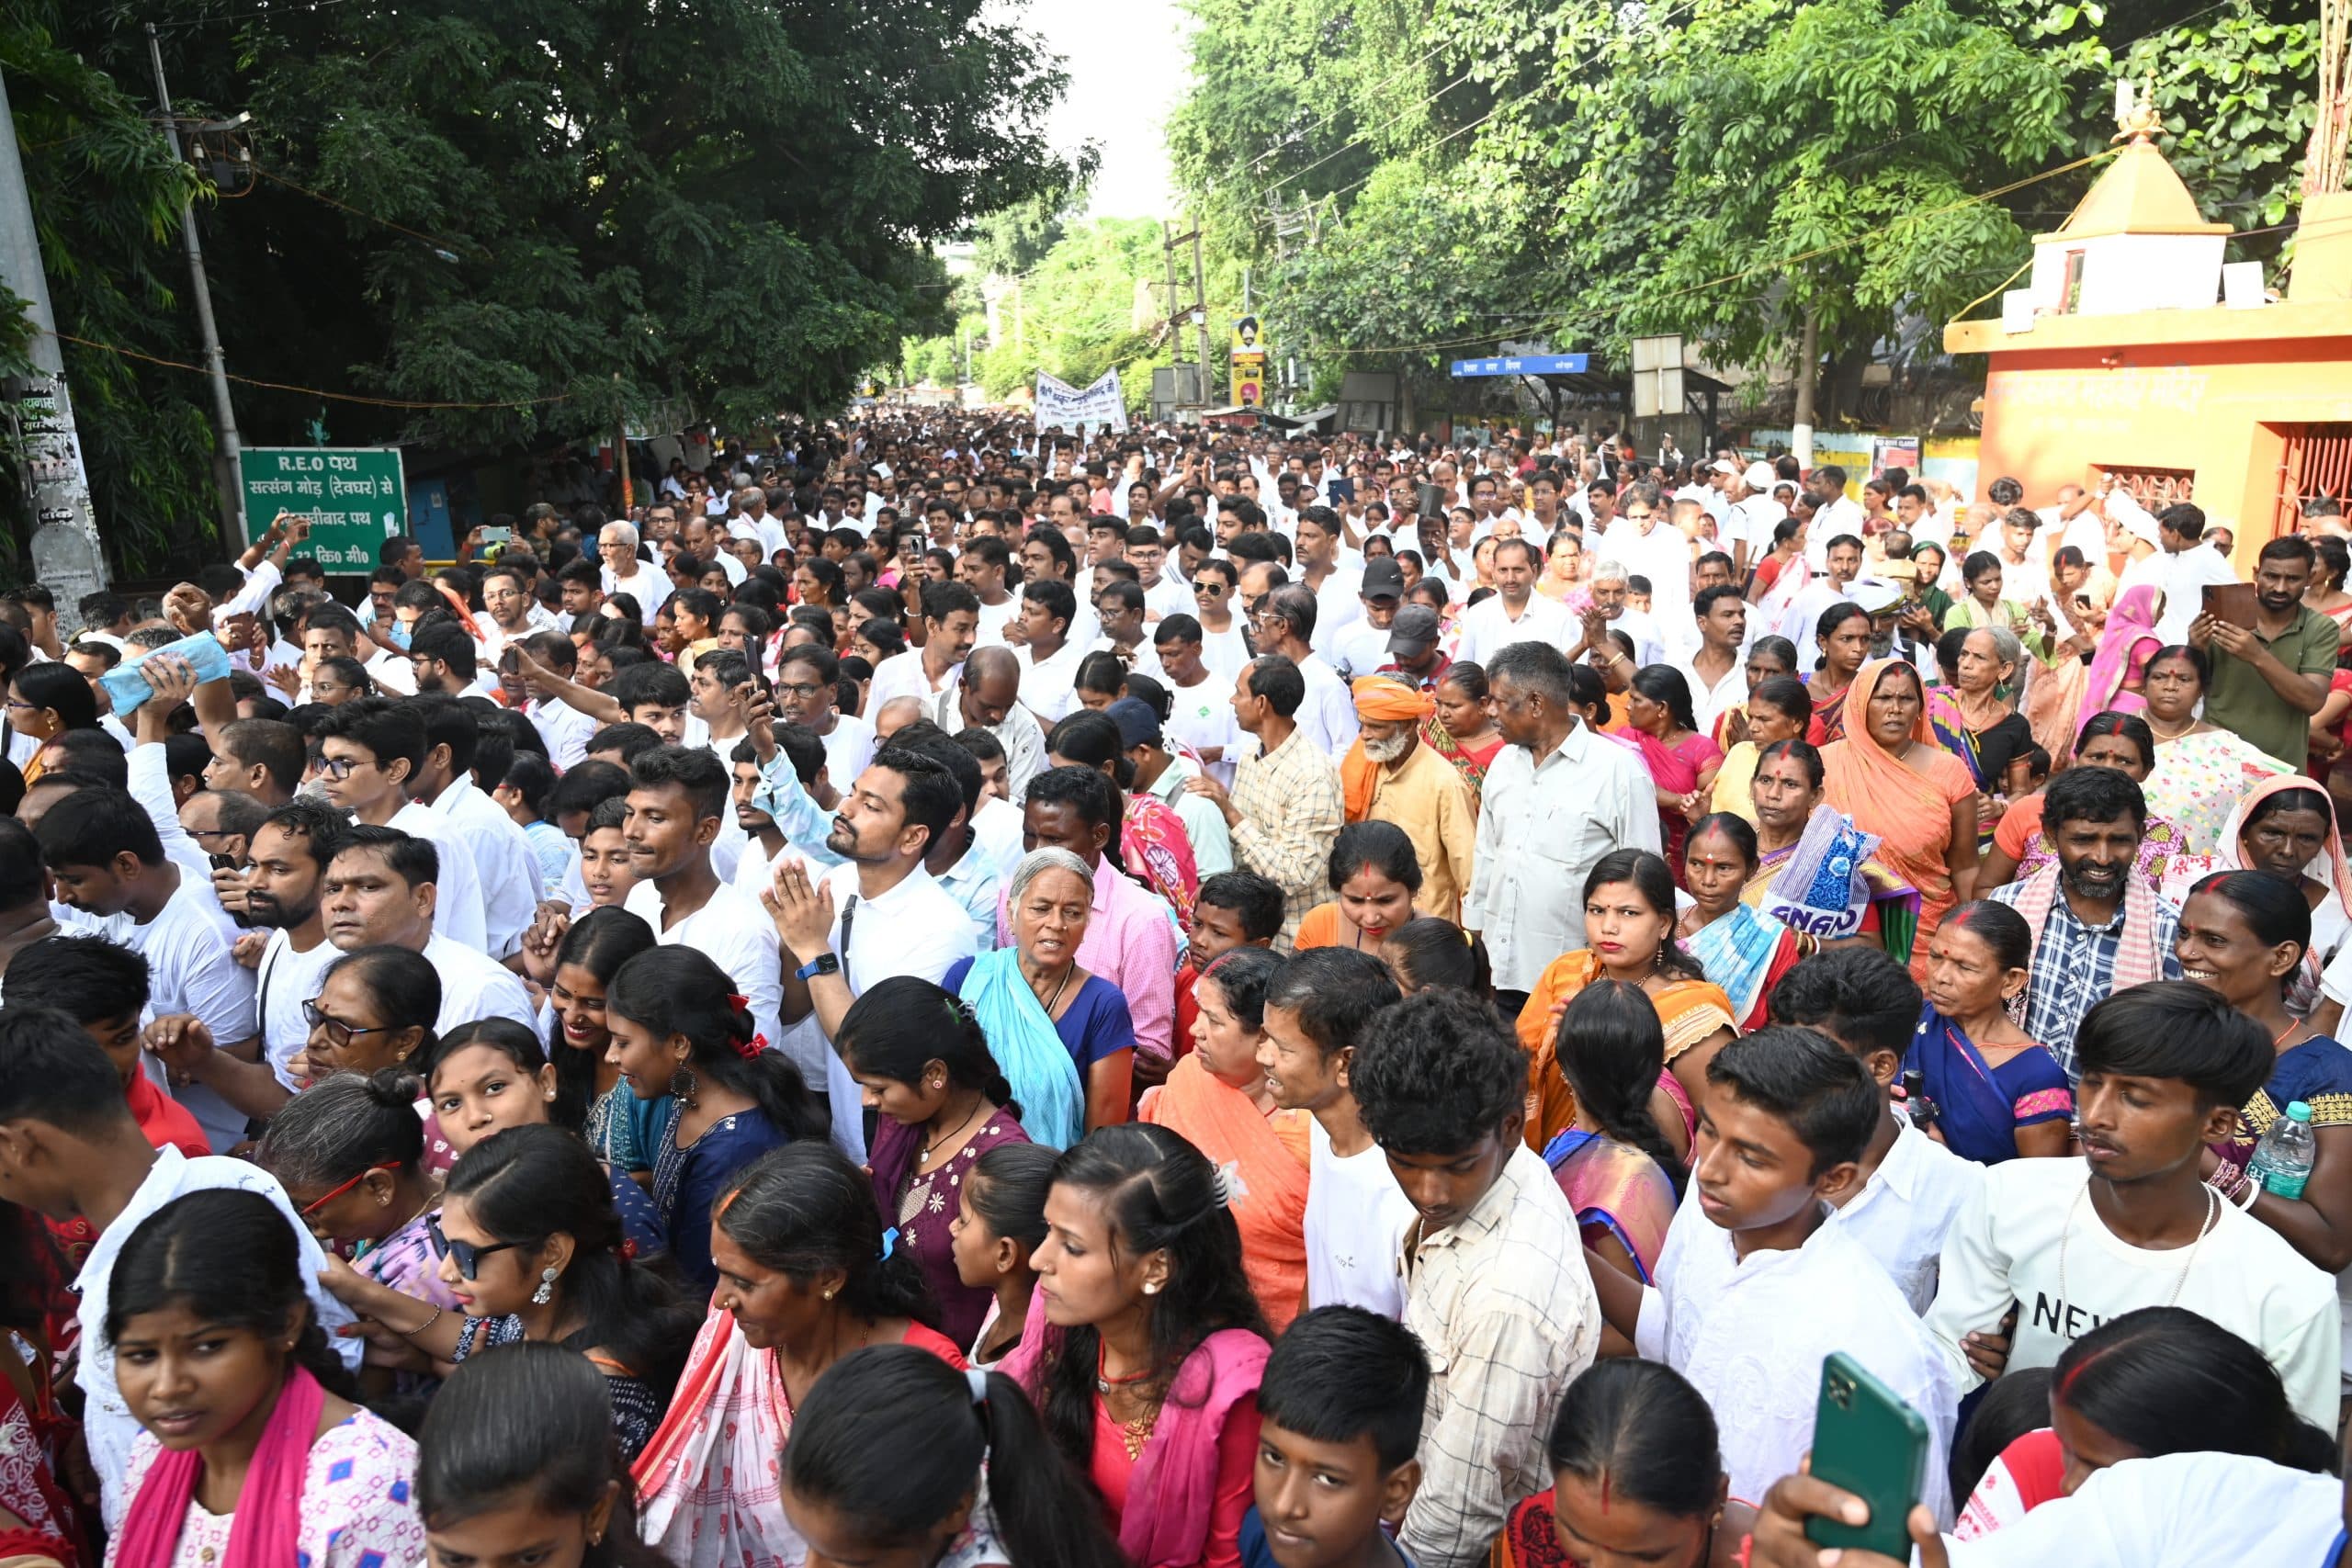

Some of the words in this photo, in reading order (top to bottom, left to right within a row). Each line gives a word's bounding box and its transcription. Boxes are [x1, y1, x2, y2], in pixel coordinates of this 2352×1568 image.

[278, 457, 323, 470] R.E.O
[249, 478, 293, 494] सत्संग
[297, 475, 322, 498] मोड़
[329, 475, 377, 499] (देवघर)
[380, 475, 393, 494] से
[349, 512, 371, 525] पथ
